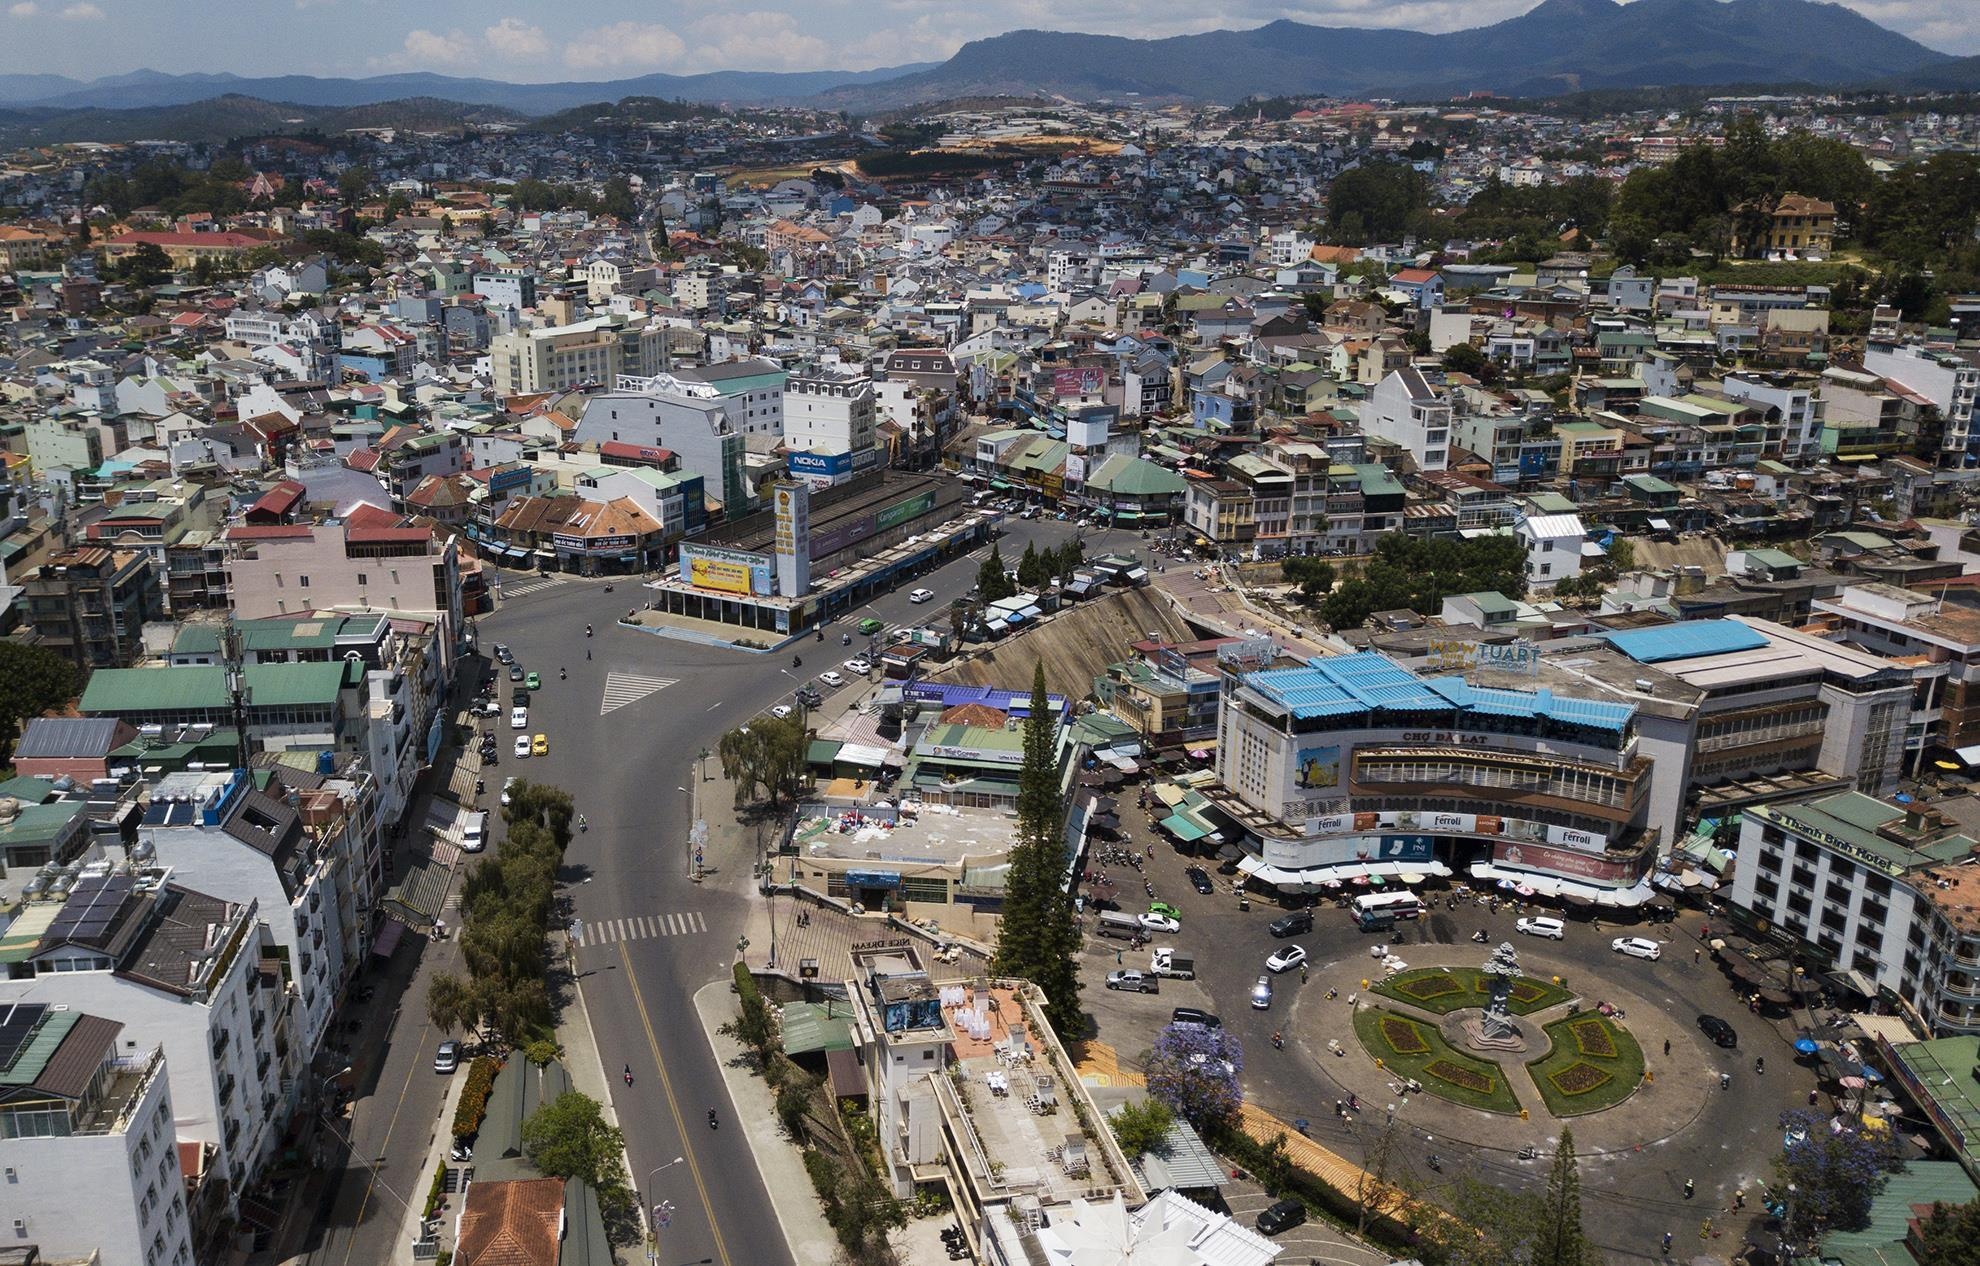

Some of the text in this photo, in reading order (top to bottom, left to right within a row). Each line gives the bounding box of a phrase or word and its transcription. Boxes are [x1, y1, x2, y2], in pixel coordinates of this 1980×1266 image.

[794, 456, 826, 467] NOKIA
[1430, 640, 1477, 654] WOW
[1479, 644, 1541, 662] TUART
[1403, 732, 1431, 743] CHỢ
[1462, 735, 1488, 745] LẠT
[1318, 819, 1341, 830] Ferroli
[1434, 815, 1461, 826] Ferroli
[1563, 832, 1591, 845] Ferroli
[1784, 815, 1822, 839] Thanh
[1855, 847, 1892, 870] Hotel
